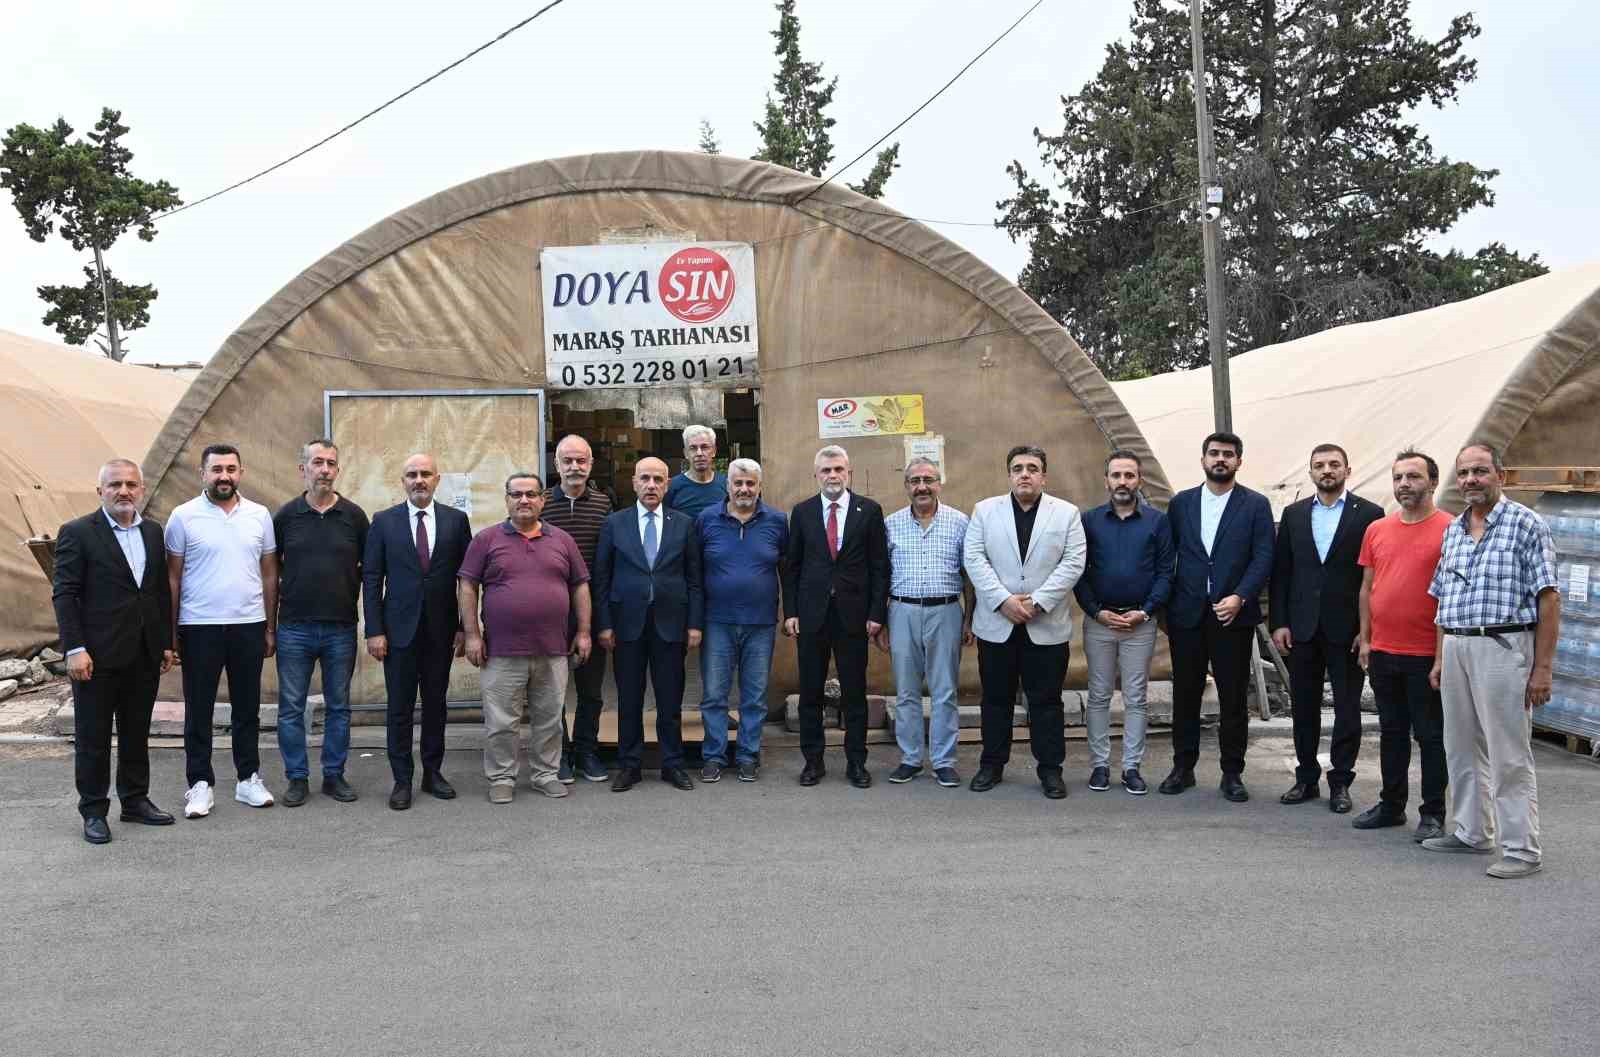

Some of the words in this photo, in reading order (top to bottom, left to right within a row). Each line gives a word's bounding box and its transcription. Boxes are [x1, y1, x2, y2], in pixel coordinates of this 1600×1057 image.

[552, 270, 651, 308] DOYA
[665, 270, 729, 303] SIN
[552, 330, 625, 354] MARAŞ
[631, 325, 751, 348] TARHANASI
[562, 365, 576, 387] 0
[583, 363, 625, 386] 532
[632, 360, 675, 383] 228
[682, 359, 708, 380] 01
[717, 356, 744, 377] 21
